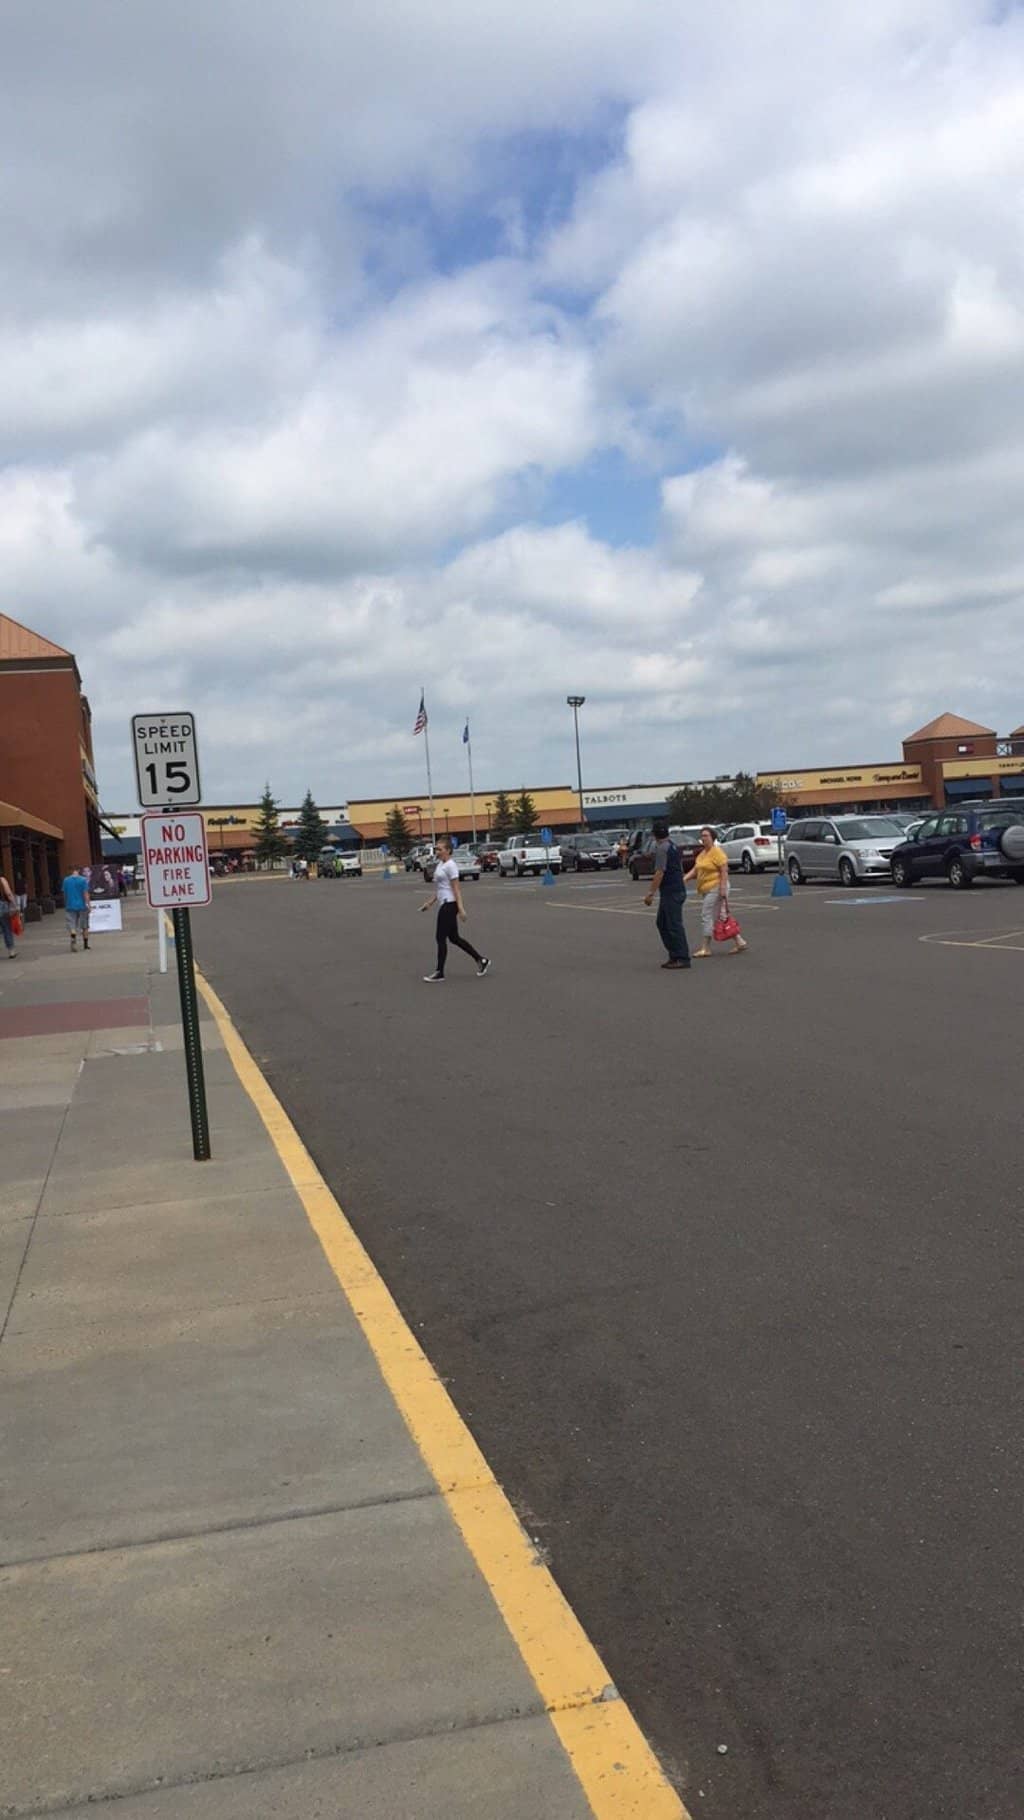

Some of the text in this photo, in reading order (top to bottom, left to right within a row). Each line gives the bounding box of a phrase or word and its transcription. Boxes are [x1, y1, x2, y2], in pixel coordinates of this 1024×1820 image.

[137, 725, 192, 739] SPEED
[144, 741, 186, 755] LIMIT
[145, 761, 191, 795] 15
[584, 794, 627, 804] TALBOTS
[161, 824, 186, 843] NO
[148, 845, 203, 866] PARKING
[163, 867, 191, 881] FIRE
[162, 883, 195, 897] LANE
